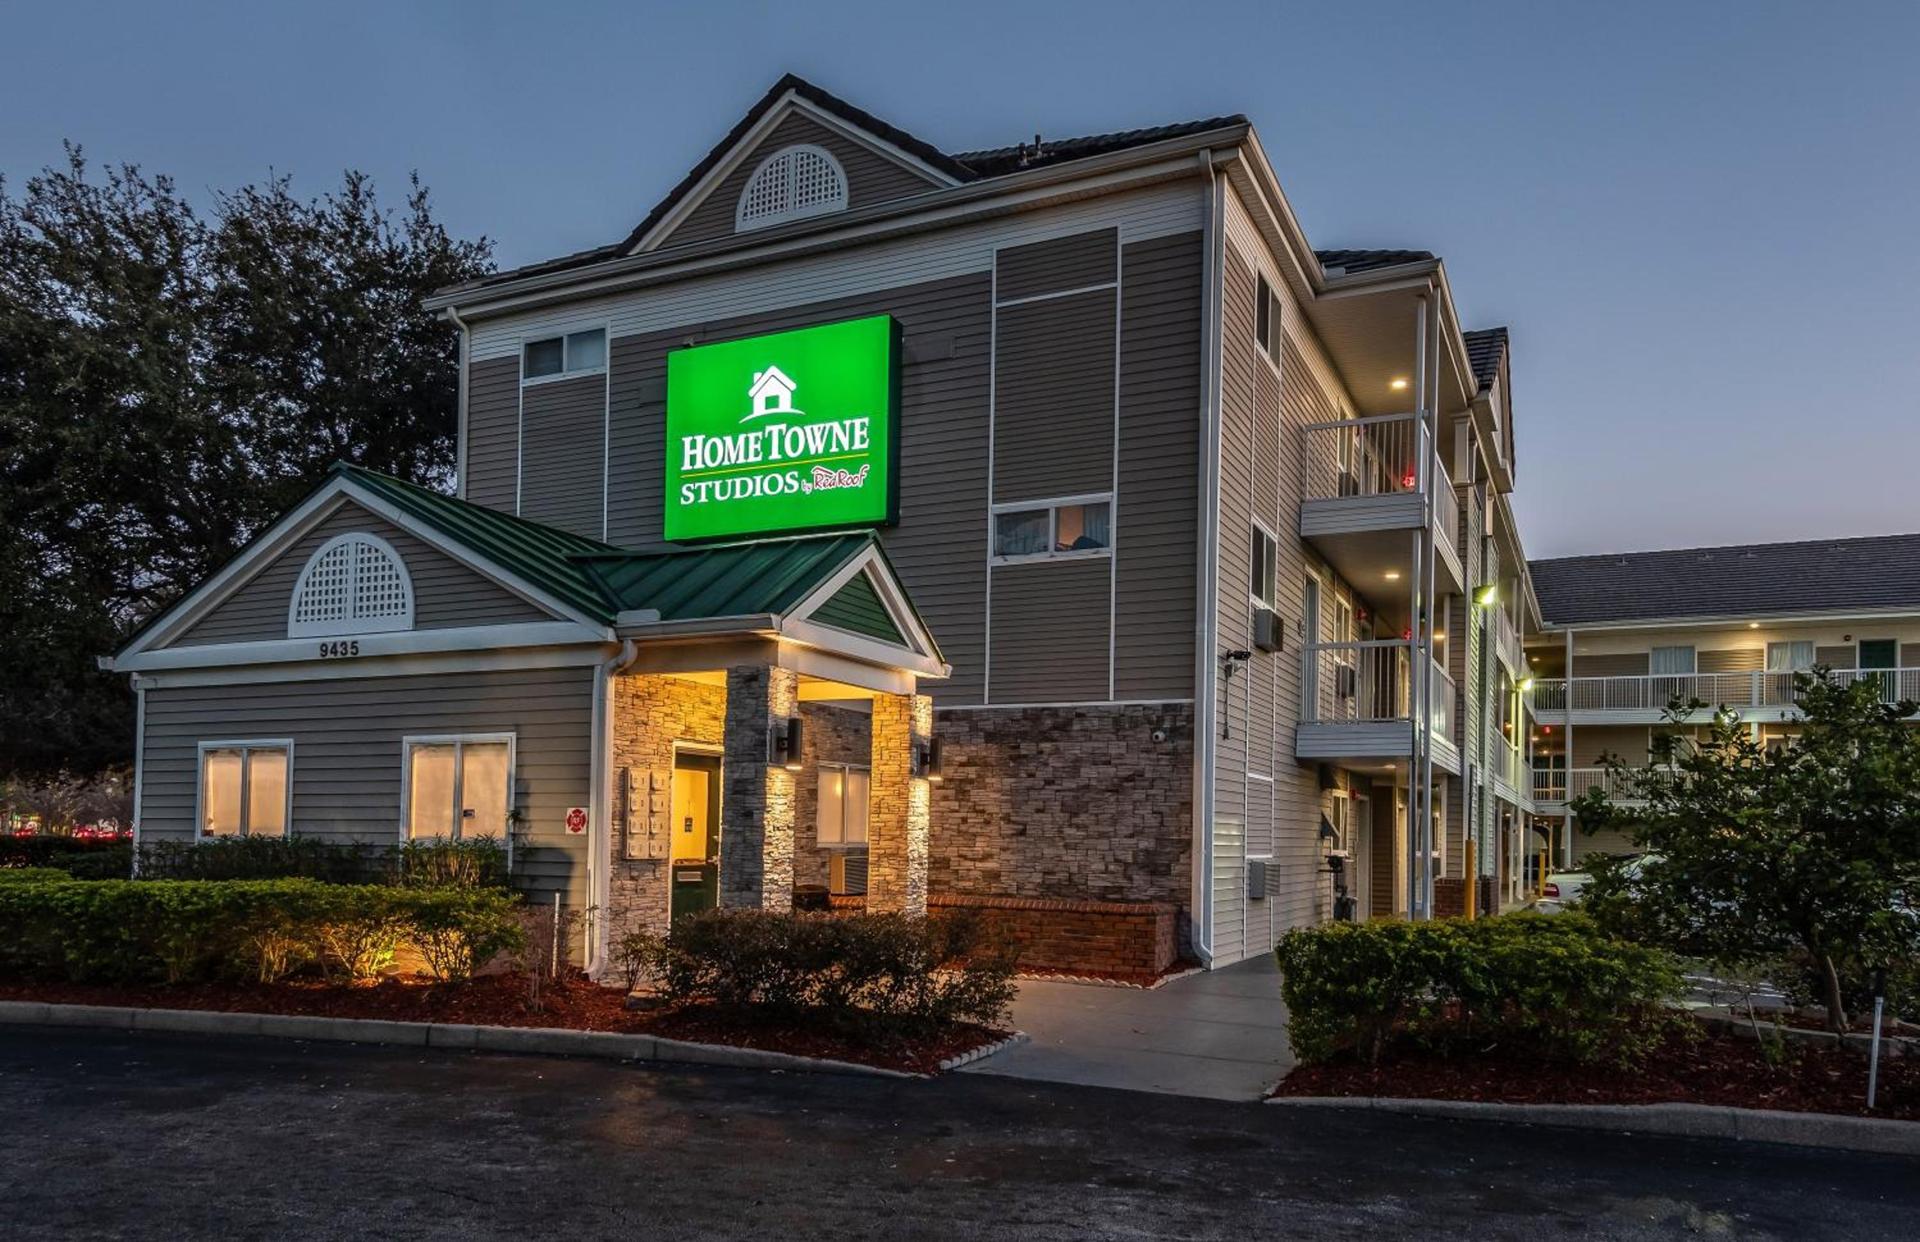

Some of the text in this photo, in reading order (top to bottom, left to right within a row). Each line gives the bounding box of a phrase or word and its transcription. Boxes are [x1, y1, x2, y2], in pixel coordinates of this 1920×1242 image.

[680, 471, 799, 505] STUDIOS
[801, 479, 812, 494] by
[320, 641, 359, 657] 9435
